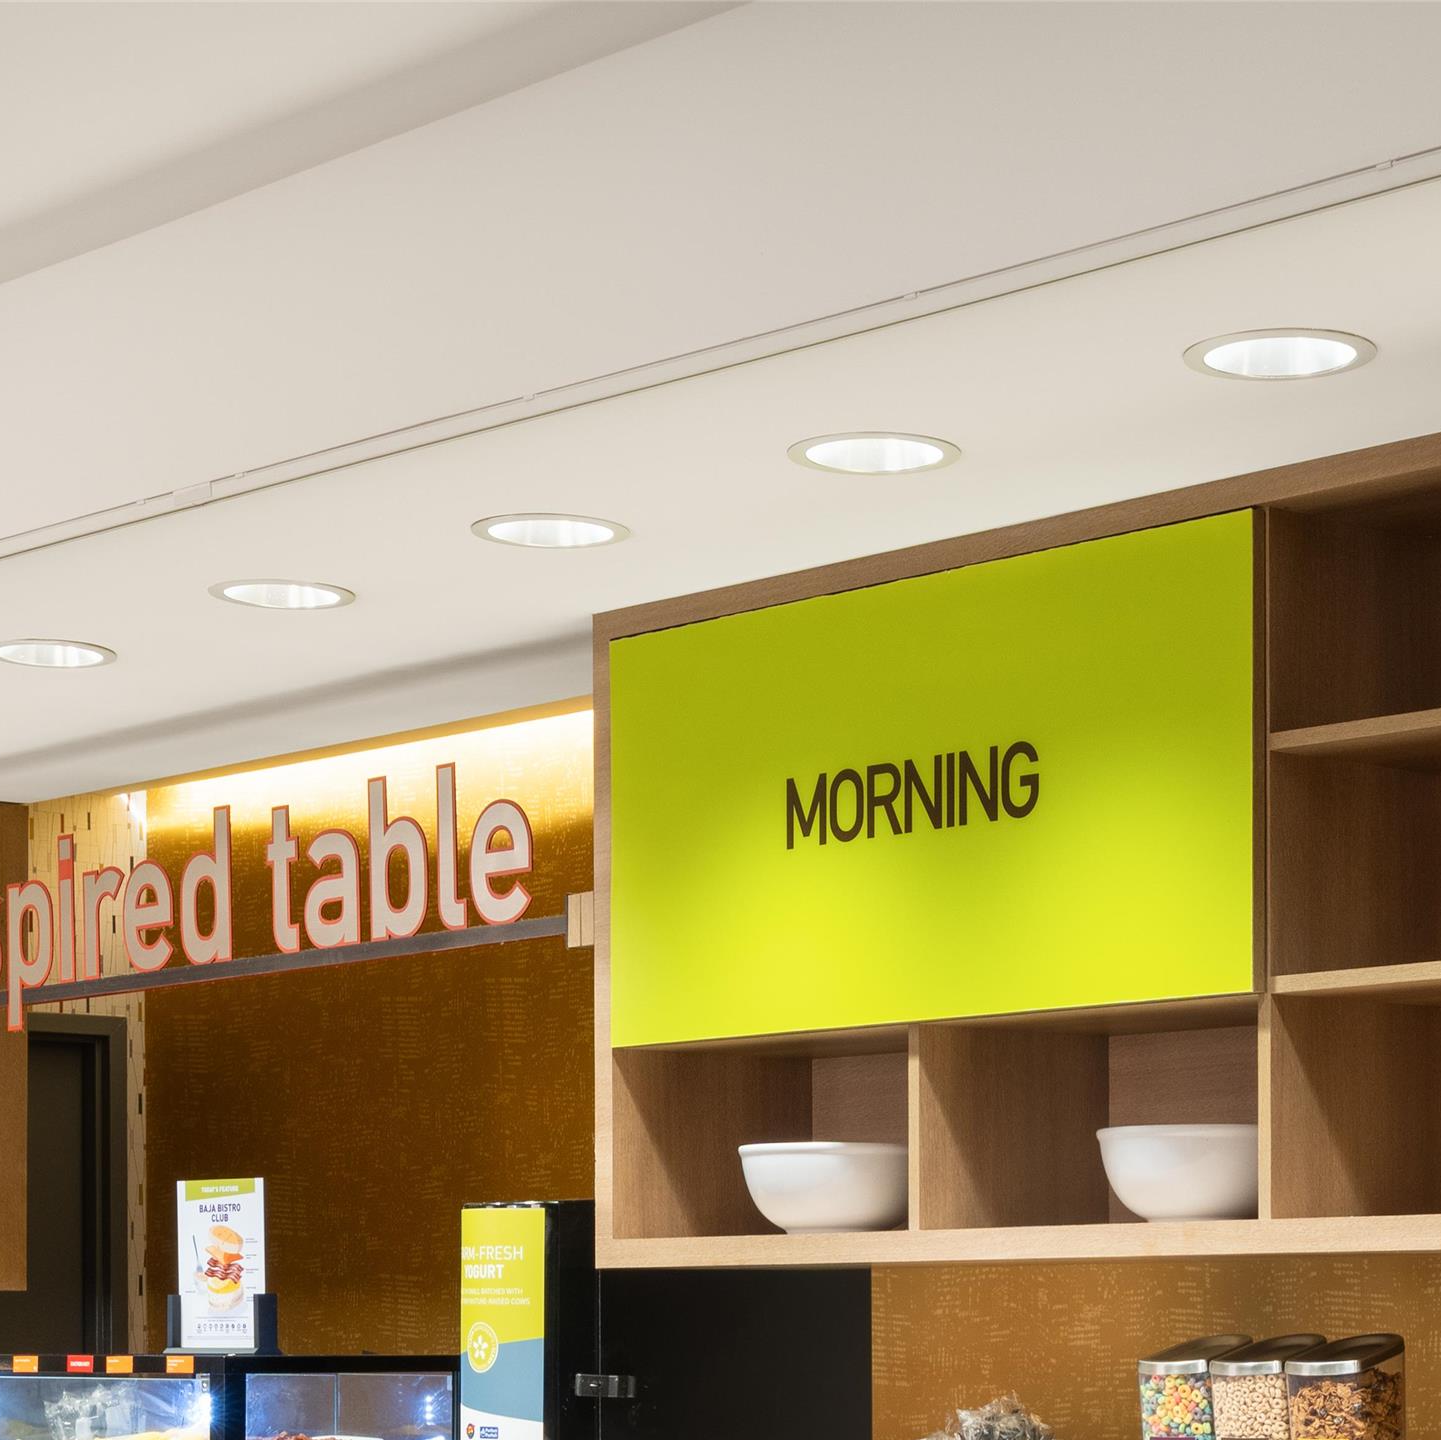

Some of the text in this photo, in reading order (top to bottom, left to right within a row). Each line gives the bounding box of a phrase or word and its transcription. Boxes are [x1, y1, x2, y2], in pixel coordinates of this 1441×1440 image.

[786, 741, 1040, 850] MORNING
[267, 762, 533, 956] table
[199, 1203, 241, 1213] BAJA BISTRO
[211, 1214, 229, 1222] CLUB
[464, 1264, 505, 1279] YOGURT
